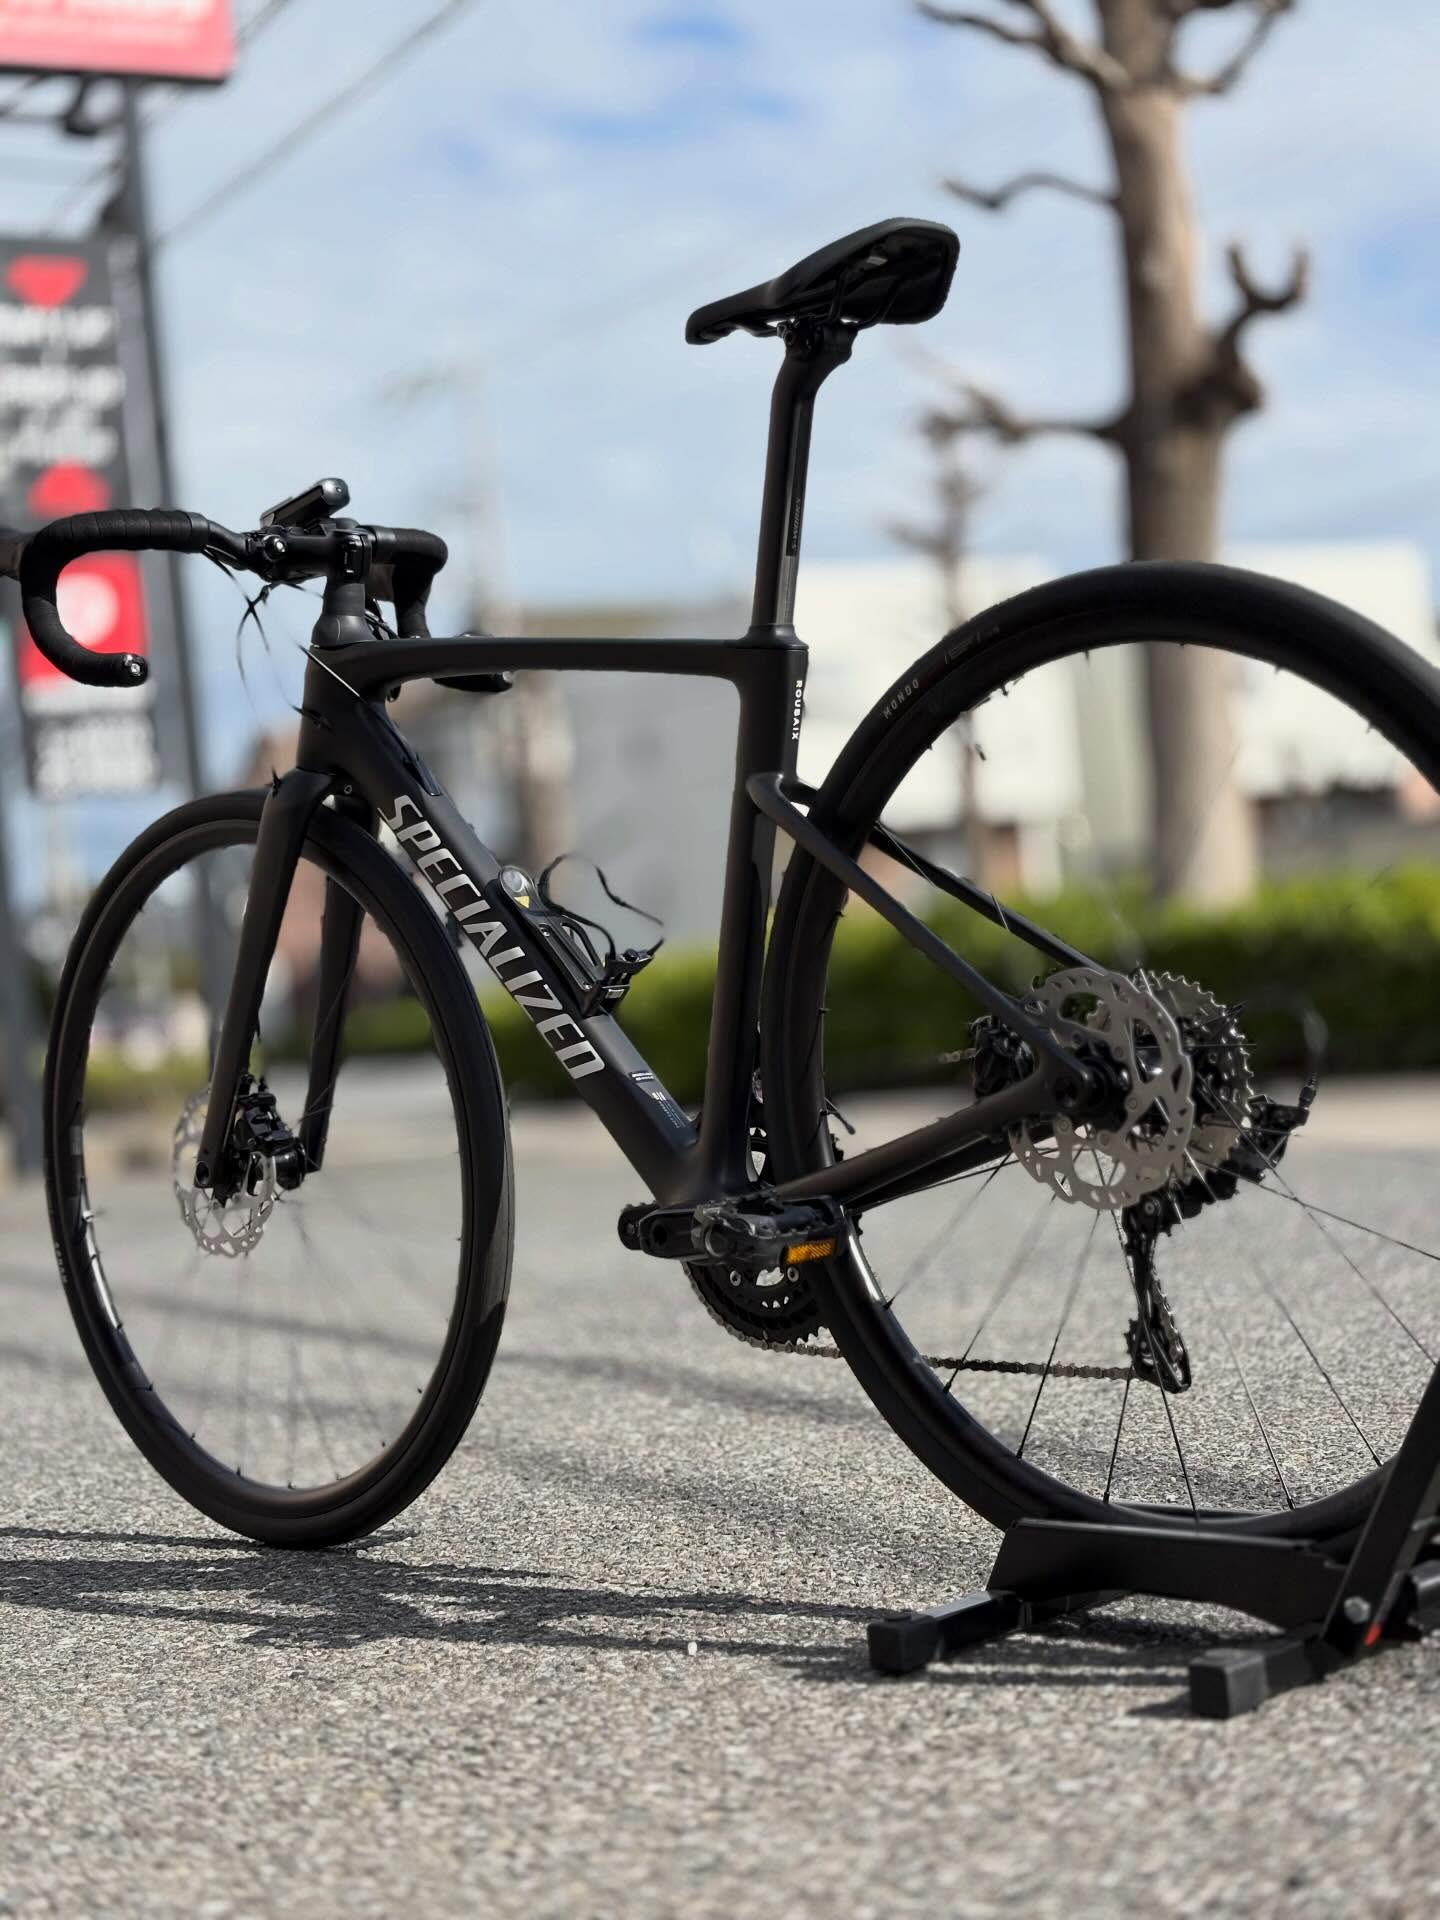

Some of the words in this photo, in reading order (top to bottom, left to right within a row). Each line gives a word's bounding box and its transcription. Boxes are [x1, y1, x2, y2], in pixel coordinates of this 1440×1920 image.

[791, 680, 802, 740] ROUBAIX
[883, 679, 919, 719] MONDO
[377, 795, 606, 1080] SPECIALIZED
